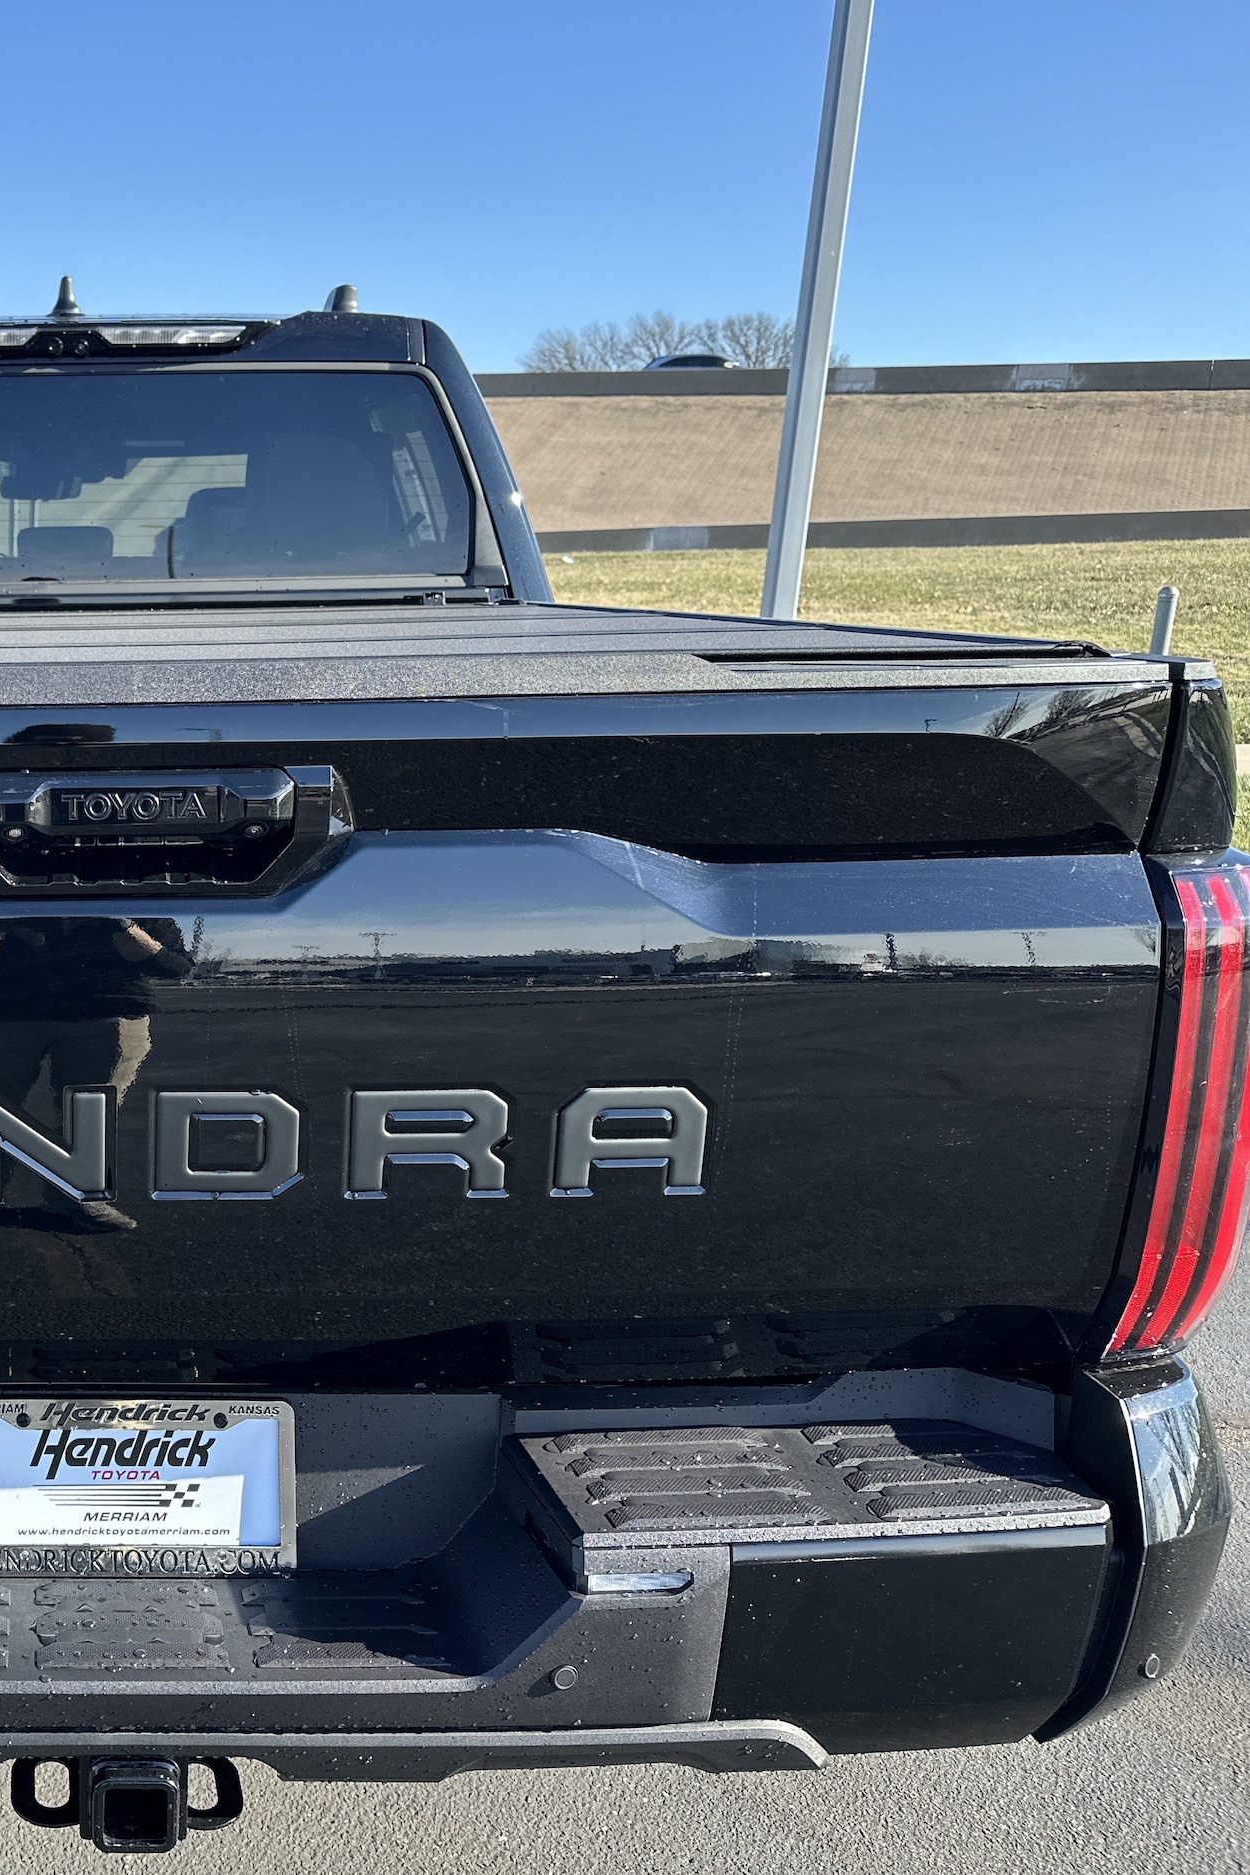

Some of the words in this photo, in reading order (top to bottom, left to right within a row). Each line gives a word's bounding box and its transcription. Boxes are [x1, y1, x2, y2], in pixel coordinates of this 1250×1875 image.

[61, 791, 208, 821] TOYOTA
[40, 1402, 211, 1426] Hendrick
[228, 1405, 280, 1415] KANSAS
[30, 1429, 216, 1480] Hendrick
[91, 1470, 161, 1480] TOYOTA
[83, 1512, 168, 1522] MERRIAM
[18, 1526, 230, 1537] www.hendricktoyotamerriam.com
